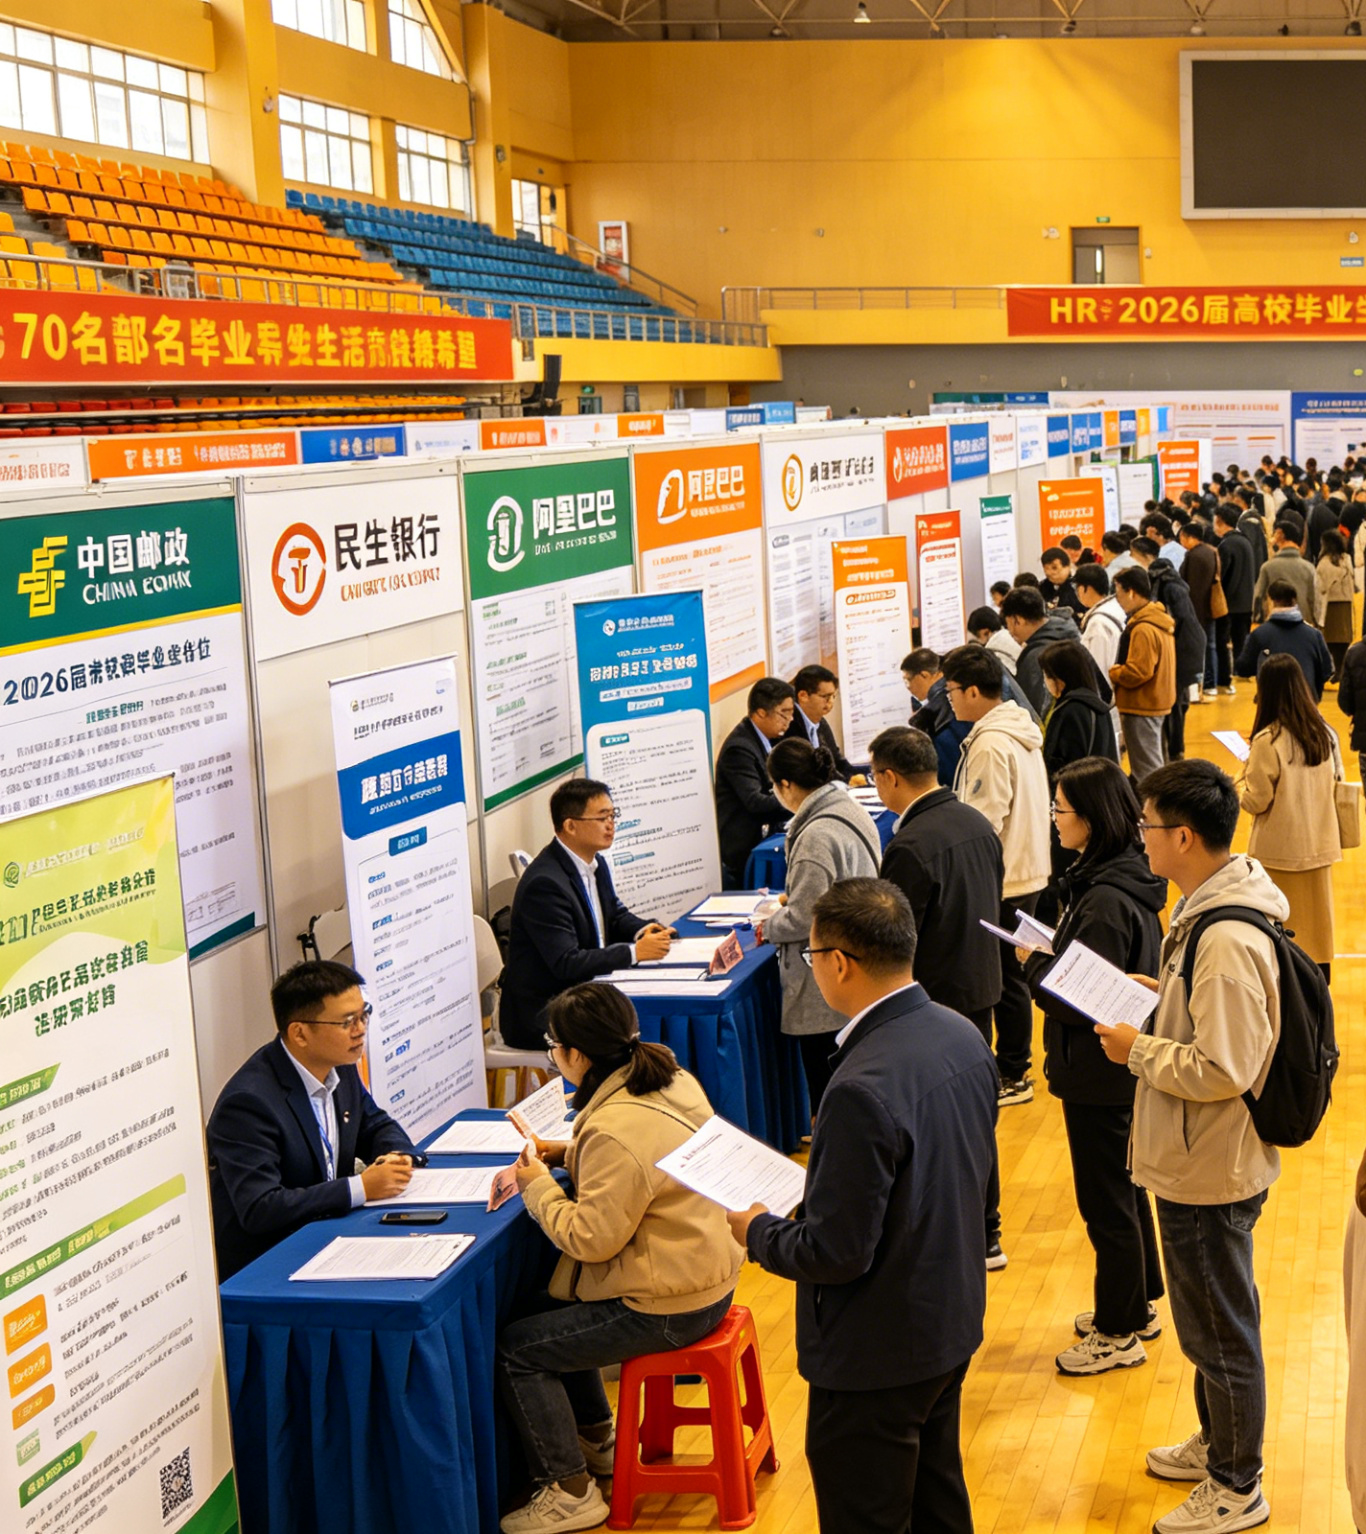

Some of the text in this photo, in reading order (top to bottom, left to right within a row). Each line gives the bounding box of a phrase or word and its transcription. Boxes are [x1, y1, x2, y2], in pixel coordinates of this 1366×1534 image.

[1050, 297, 1098, 323] HR
[77, 527, 190, 579] 中国邮政
